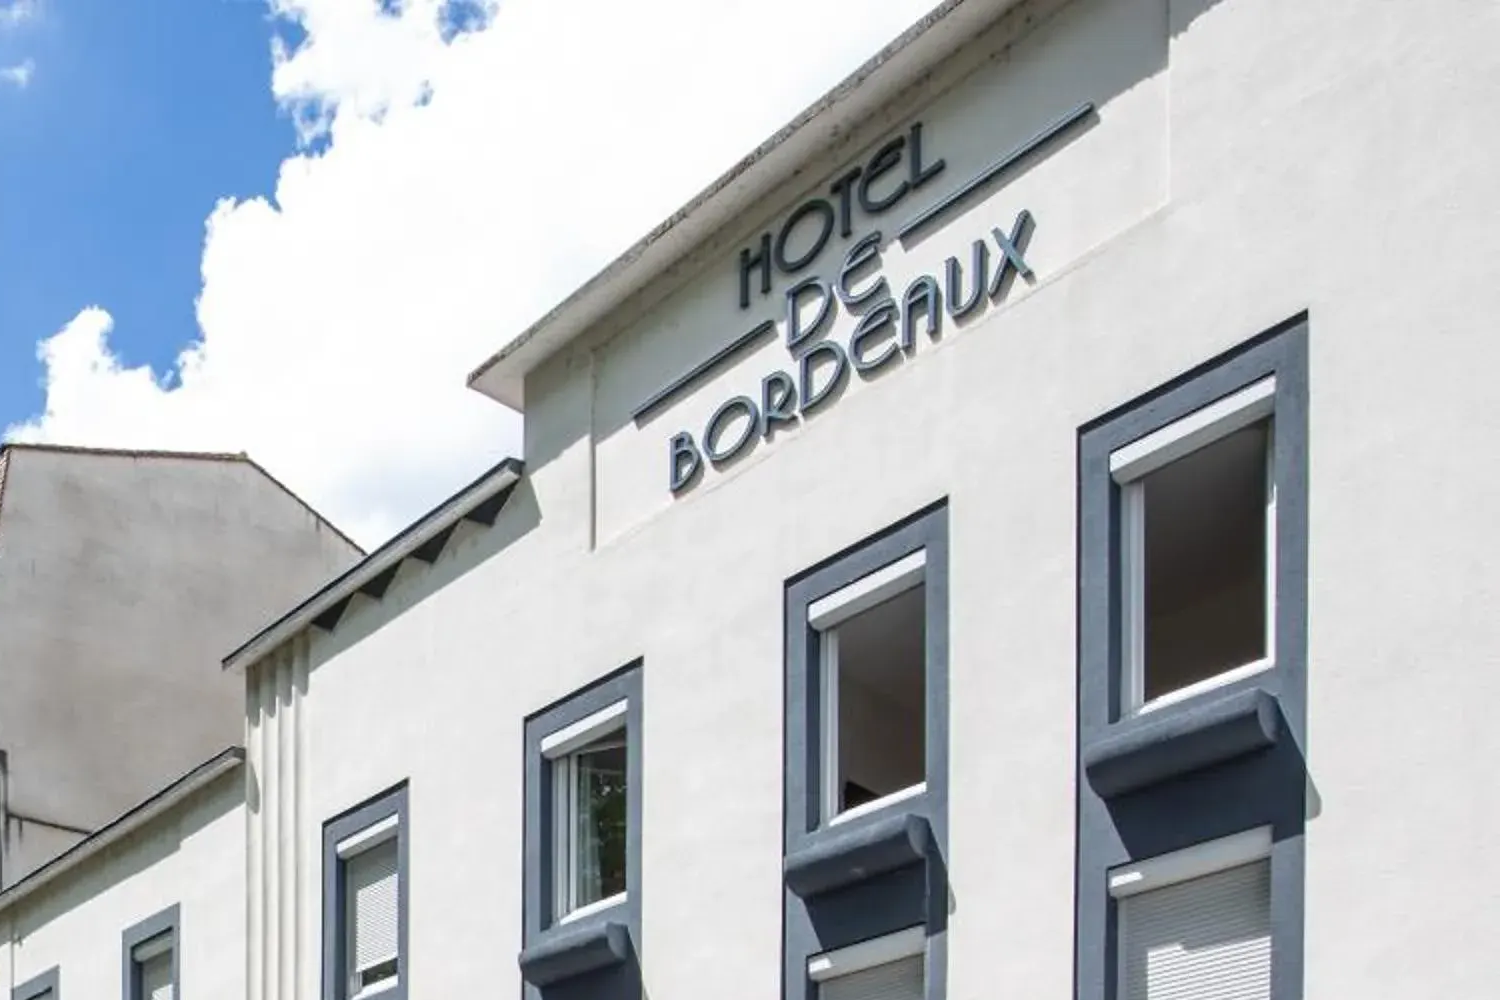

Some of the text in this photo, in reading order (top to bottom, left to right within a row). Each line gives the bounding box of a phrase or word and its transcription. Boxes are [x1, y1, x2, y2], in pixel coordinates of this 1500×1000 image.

[739, 121, 946, 309] HOTEL
[786, 230, 887, 349] DE
[669, 208, 1036, 493] BORDEAUX
